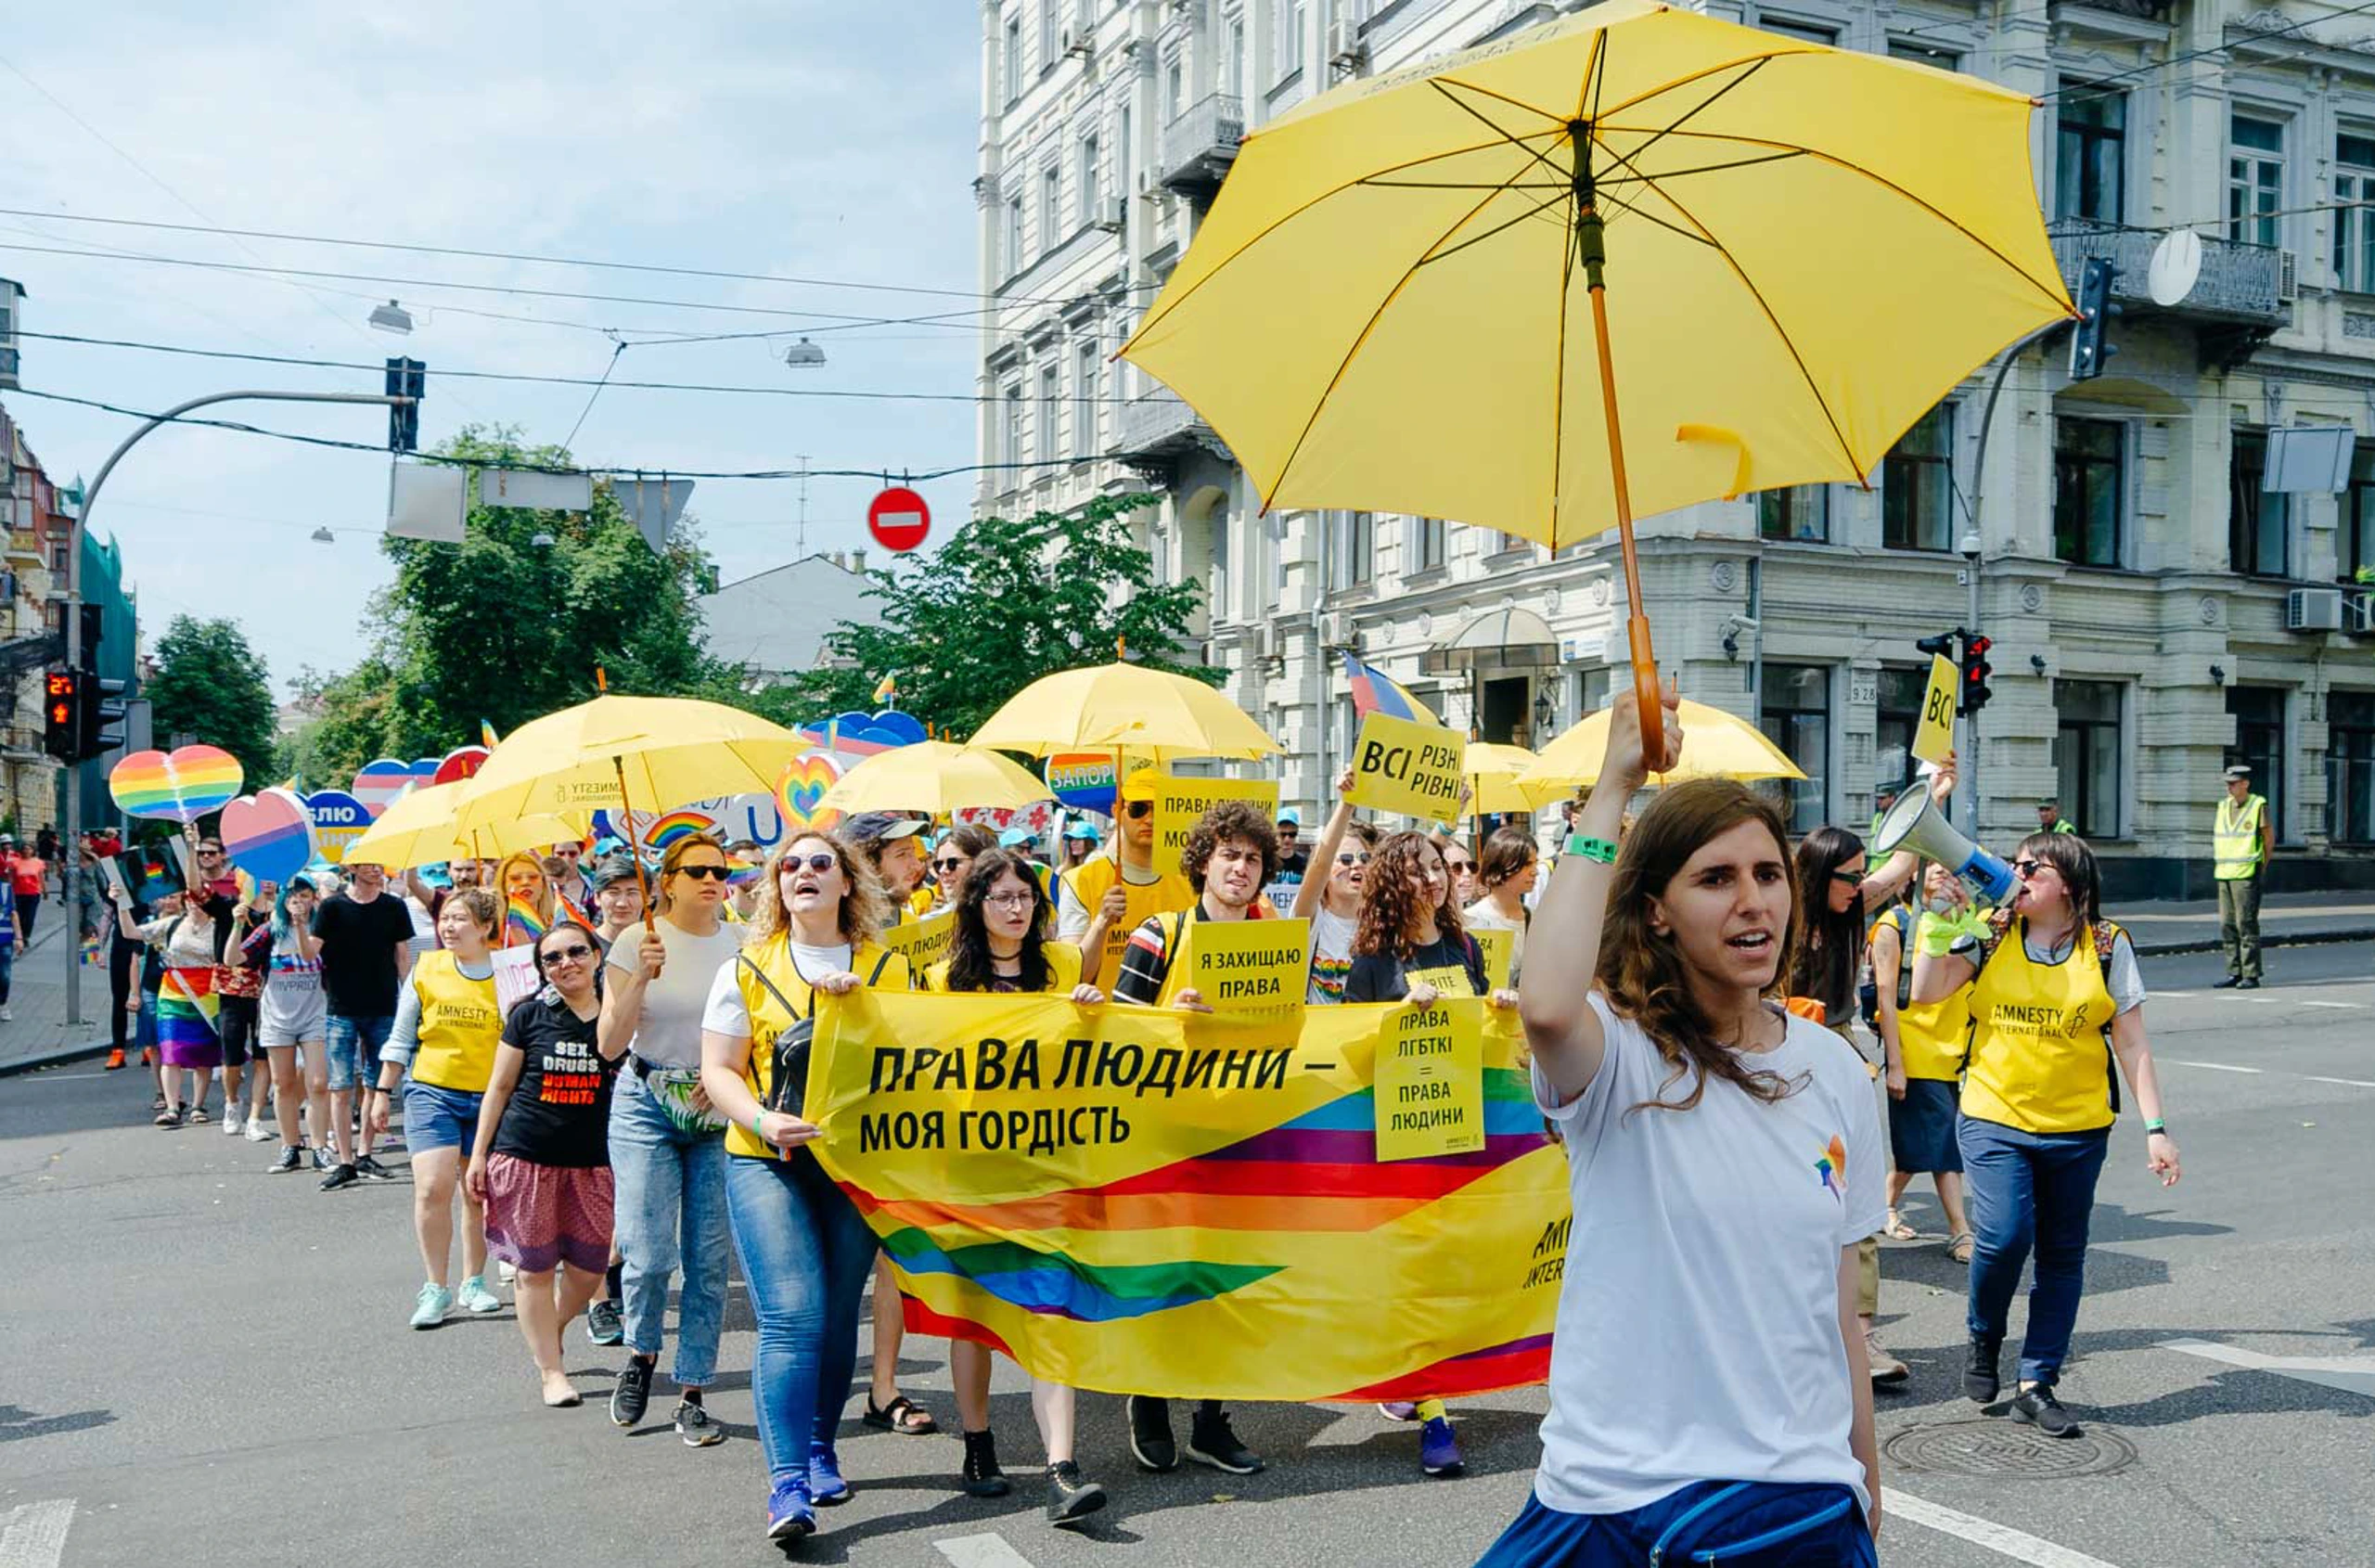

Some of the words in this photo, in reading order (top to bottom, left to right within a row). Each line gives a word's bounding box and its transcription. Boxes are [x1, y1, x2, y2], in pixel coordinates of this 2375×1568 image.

[1927, 687, 1955, 731] ВСІ
[1361, 740, 1412, 780] ВСІ
[1419, 745, 1461, 771] РІЗНІ
[1410, 772, 1459, 800] РІВНІ
[1201, 953, 1211, 970] Я
[1216, 948, 1301, 969] ЗАХИЩАЮ
[1220, 977, 1280, 998] ПРАВА
[437, 1005, 489, 1021] AMNESTY
[1399, 1010, 1449, 1031] ПРАВА
[1995, 1005, 2063, 1025] AMNESTY
[1398, 1036, 1452, 1057] ЛГБТКІ
[869, 1038, 1040, 1095] ПРАВА
[1053, 1040, 1295, 1098] ЛЮДИНИ
[1400, 1082, 1451, 1102] ПРАВА
[1392, 1107, 1463, 1131] ЛЮДИНИ
[860, 1112, 944, 1152] МОЯ
[958, 1106, 1130, 1156] ГОРДІСТЬ
